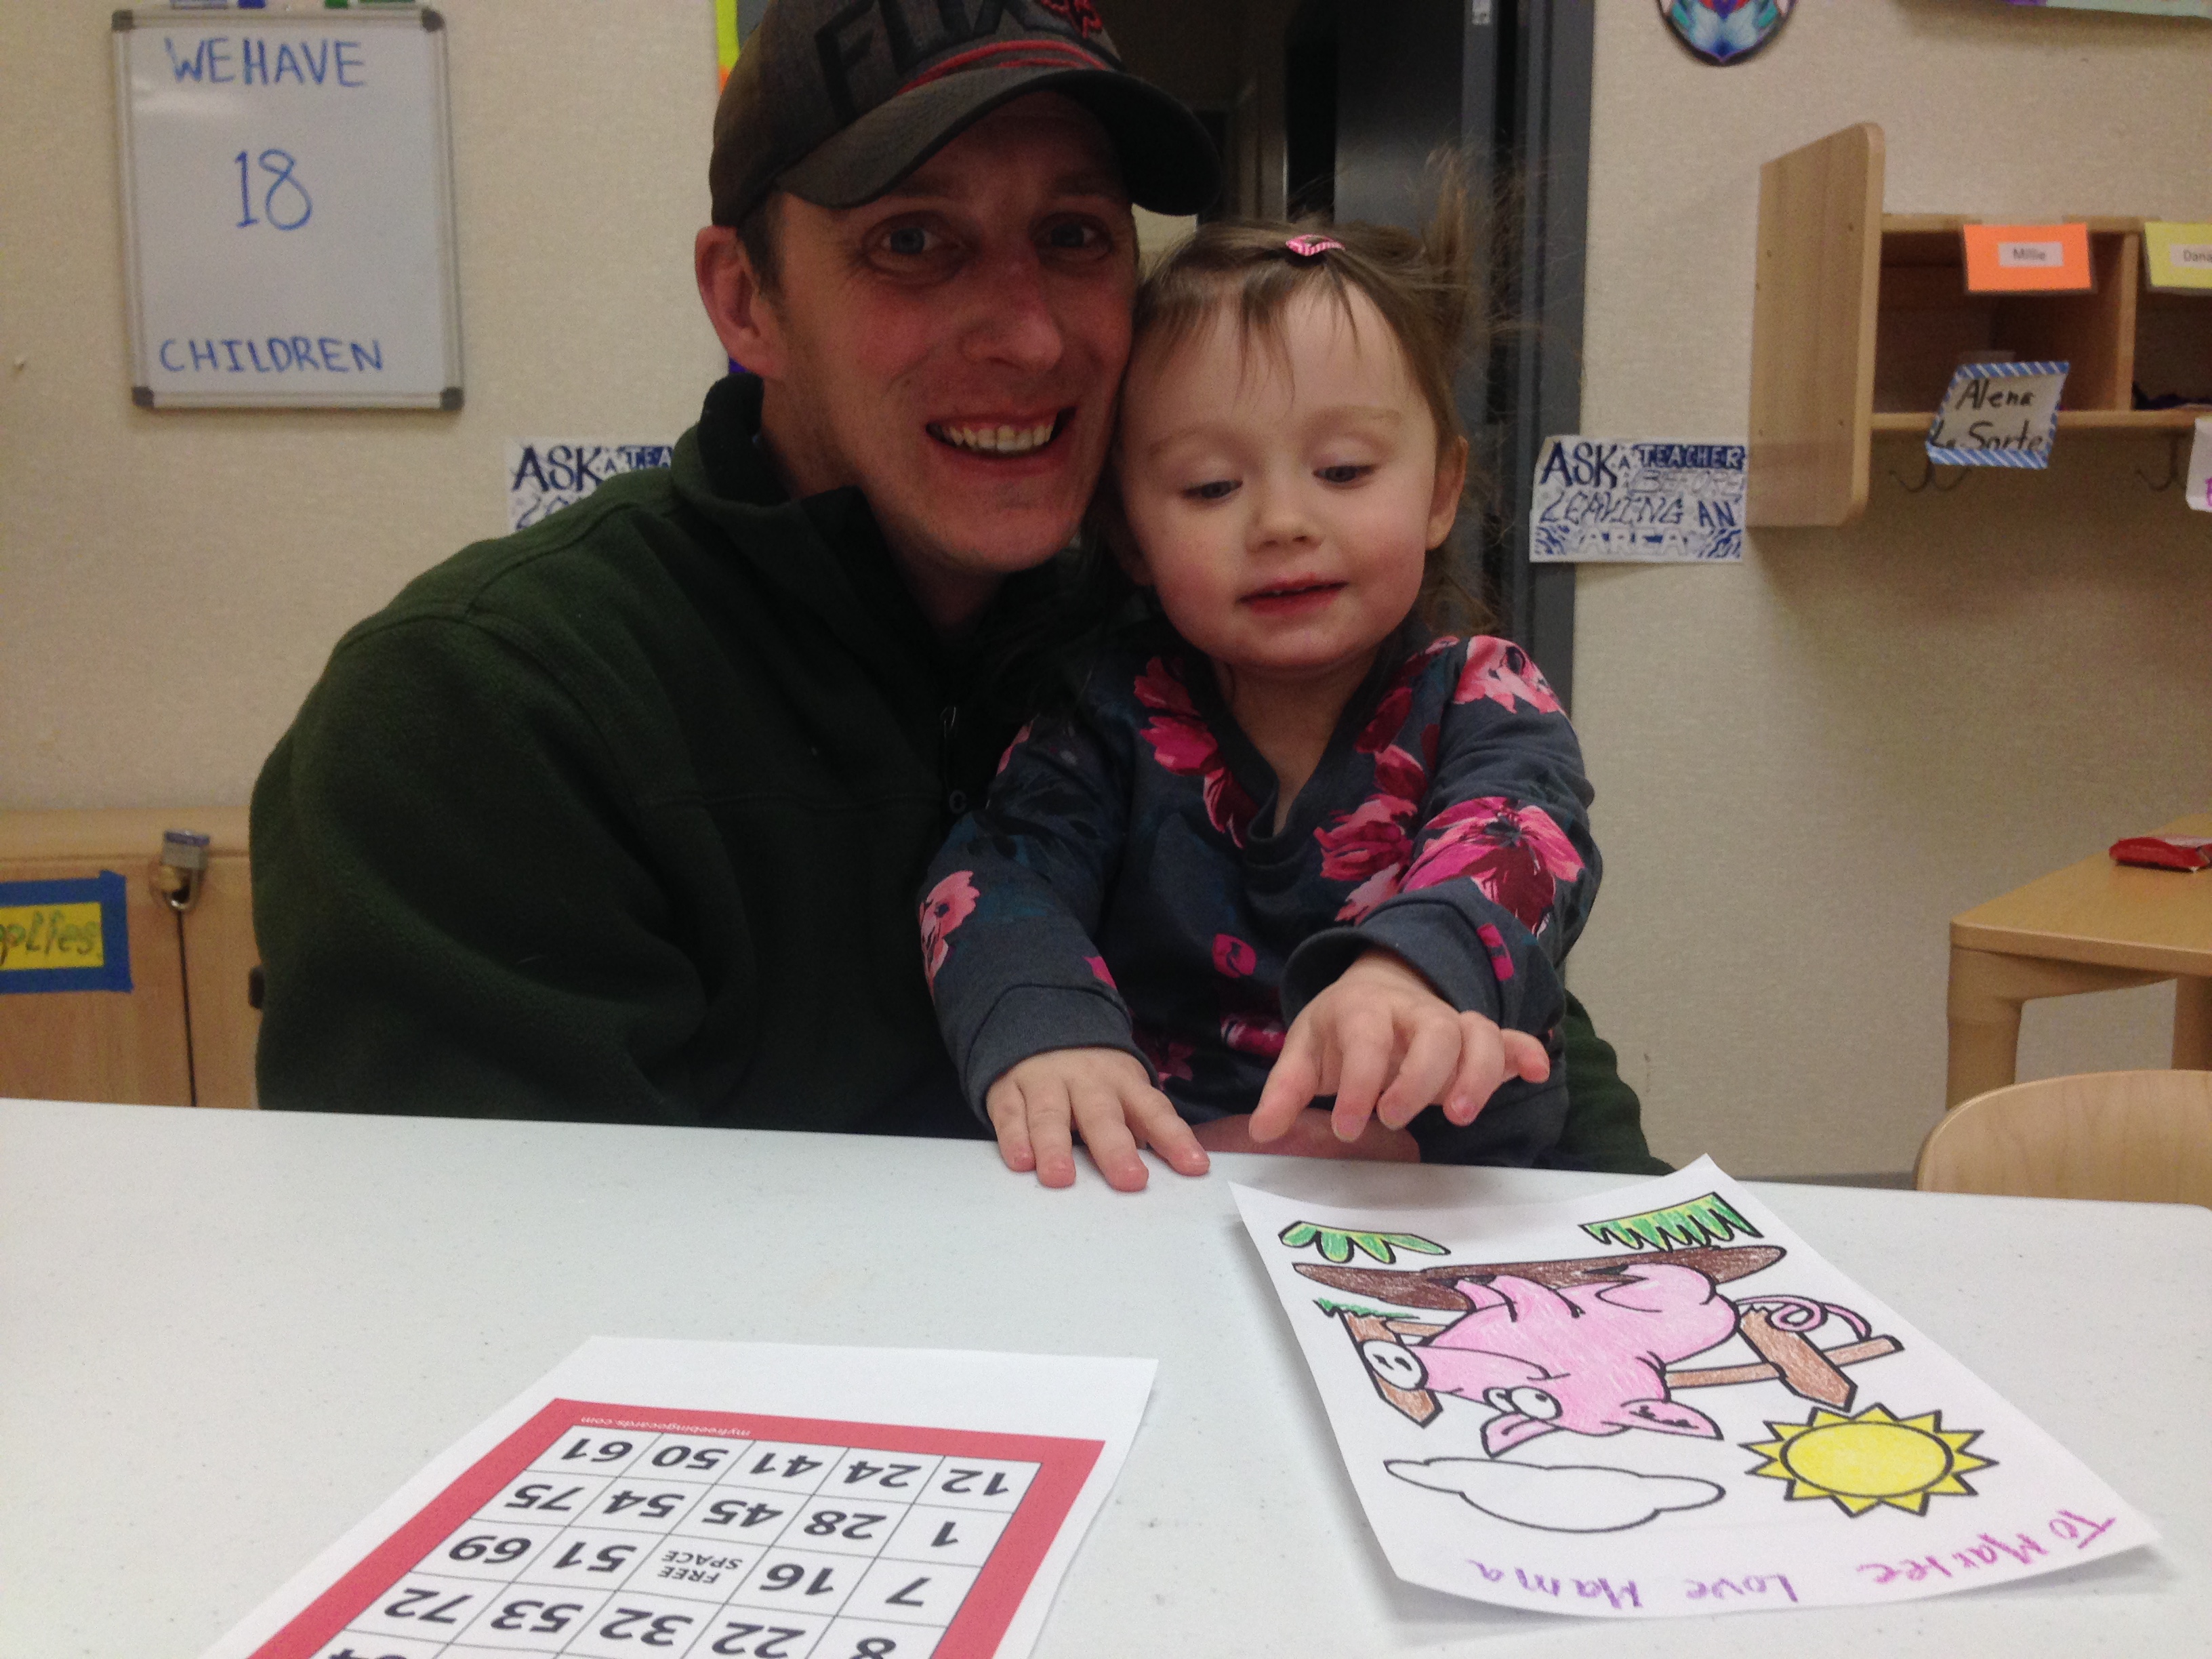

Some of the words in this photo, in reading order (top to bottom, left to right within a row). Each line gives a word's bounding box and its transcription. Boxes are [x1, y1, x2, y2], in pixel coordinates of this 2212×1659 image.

[234, 148, 313, 231] 18
[159, 337, 384, 373] CHILDREN
[511, 444, 605, 493] ASK
[1539, 441, 1618, 489] ASK
[1637, 445, 1744, 470] TEACHER
[1539, 491, 1685, 525] LEAVING
[1696, 499, 1737, 530] AN
[561, 1437, 634, 1462] 61
[651, 1446, 729, 1471] 50
[750, 1452, 823, 1478] 41
[844, 1460, 922, 1488] 24
[505, 1483, 584, 1511] 75
[941, 1469, 1009, 1496] 12
[603, 1490, 685, 1519] 54
[702, 1500, 783, 1528] 45
[803, 1510, 887, 1540] 28
[931, 1521, 959, 1548] 1
[2048, 1509, 2116, 1550] To
[448, 1535, 532, 1564] 69
[553, 1541, 637, 1572] 51
[662, 1549, 743, 1571] SPACE
[1856, 1532, 2049, 1584] Marlee
[657, 1565, 722, 1585] FREE
[759, 1563, 834, 1596] 16
[1467, 1559, 1643, 1610] Mama
[1686, 1574, 1799, 1603] Love
[384, 1588, 472, 1624] 72
[885, 1577, 930, 1607] 7
[490, 1600, 583, 1633] 53
[599, 1607, 693, 1646] 32
[712, 1622, 806, 1659] 22
